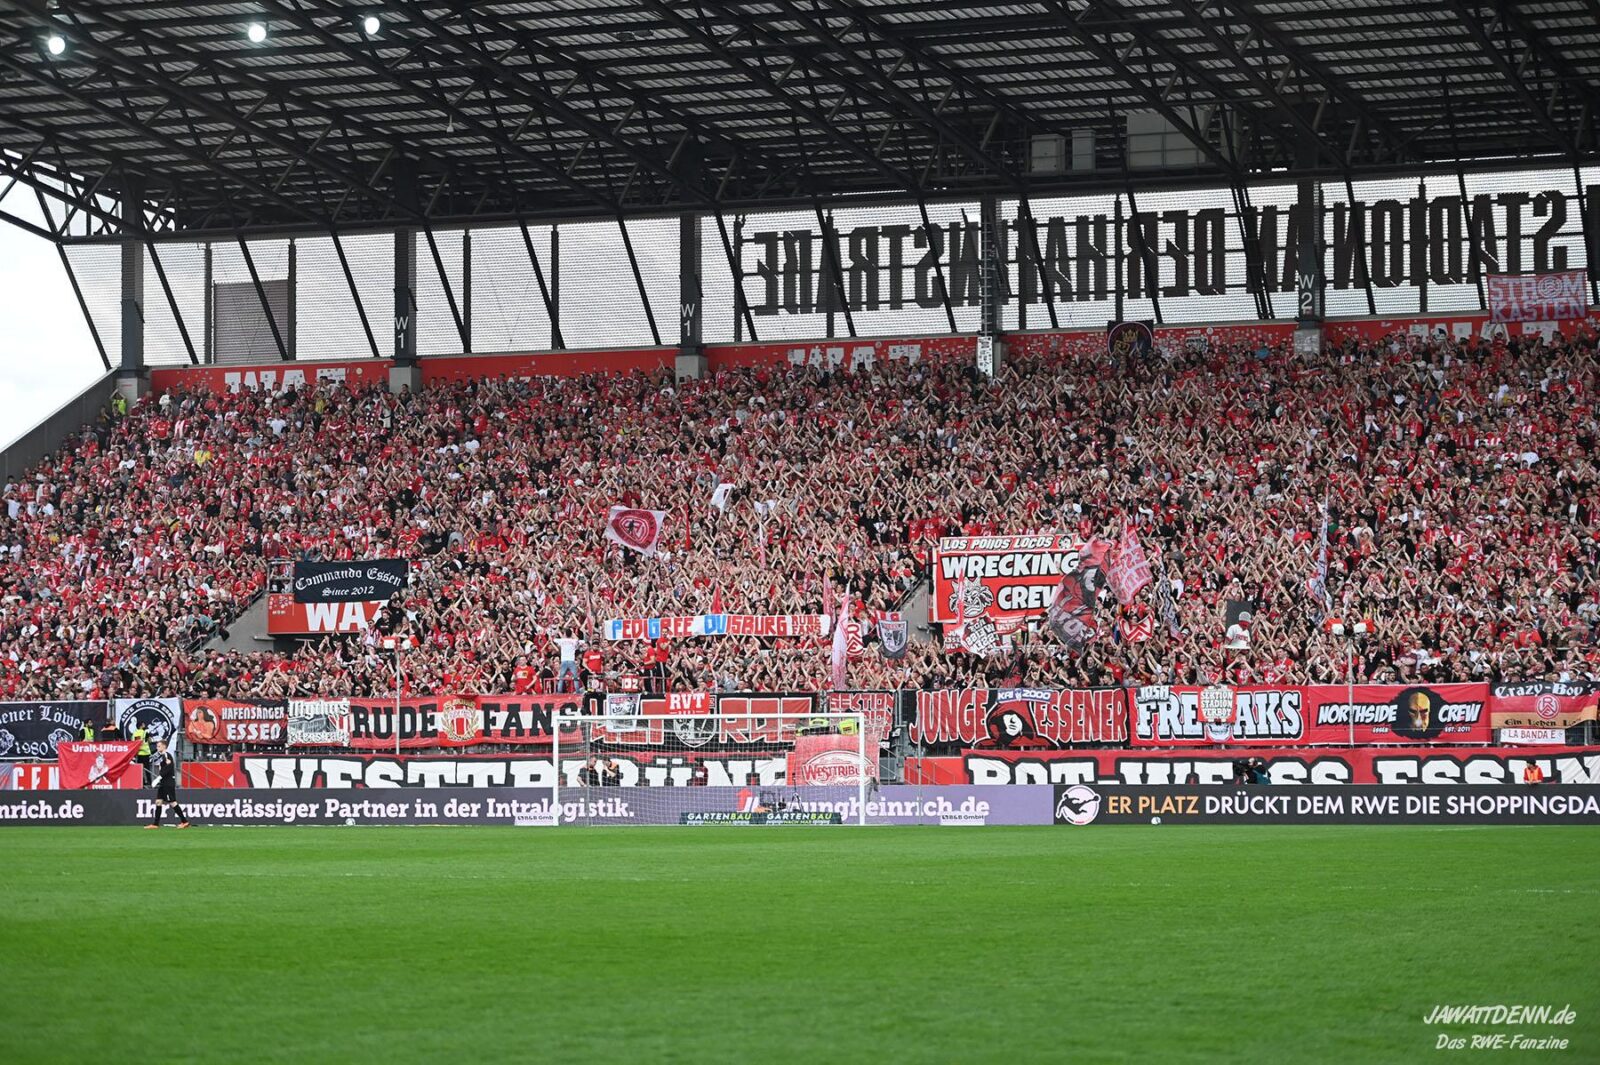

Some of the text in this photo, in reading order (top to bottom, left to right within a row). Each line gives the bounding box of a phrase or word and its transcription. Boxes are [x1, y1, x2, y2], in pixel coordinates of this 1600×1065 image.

[1299, 275, 1314, 289] W
[1301, 292, 1312, 308] 2
[681, 303, 695, 317] W
[1491, 297, 1585, 322] KASTEN
[395, 316, 408, 330] W
[684, 320, 691, 336] 1
[398, 334, 405, 349] 1
[944, 539, 967, 550] LOS
[1014, 537, 1054, 550] LOCOS
[941, 552, 1079, 578] WRECKING
[295, 567, 402, 590] Commando Essen
[321, 585, 375, 597] Since 2012
[704, 614, 788, 637] DUISBURG
[669, 692, 706, 710] RVT
[1022, 690, 1051, 700] 2000
[0, 709, 34, 725] ener
[351, 703, 438, 740] RUDE
[480, 702, 579, 737] FANS
[909, 688, 1128, 744] JUNGE ESSENER
[1317, 702, 1484, 726] NORTHSIDE CREW
[1508, 730, 1518, 738] LA
[1520, 730, 1549, 739] BANDA
[14, 740, 49, 756] 1980
[72, 743, 129, 753] Uralt-Ultras
[324, 799, 410, 818] Partner
[414, 798, 438, 818] in
[443, 798, 481, 818] der
[486, 798, 635, 823] Intralogistik.
[1138, 796, 1199, 814] PLATZ
[1205, 791, 1291, 815] DRÜCKT
[1297, 796, 1345, 815] DEM
[1351, 796, 1400, 815] RWE
[1406, 796, 1441, 815] DIE
[1447, 795, 1600, 815] SHOPPINGDA
[687, 812, 752, 820] GARTENBAU
[766, 812, 832, 820] GARTENBAU
